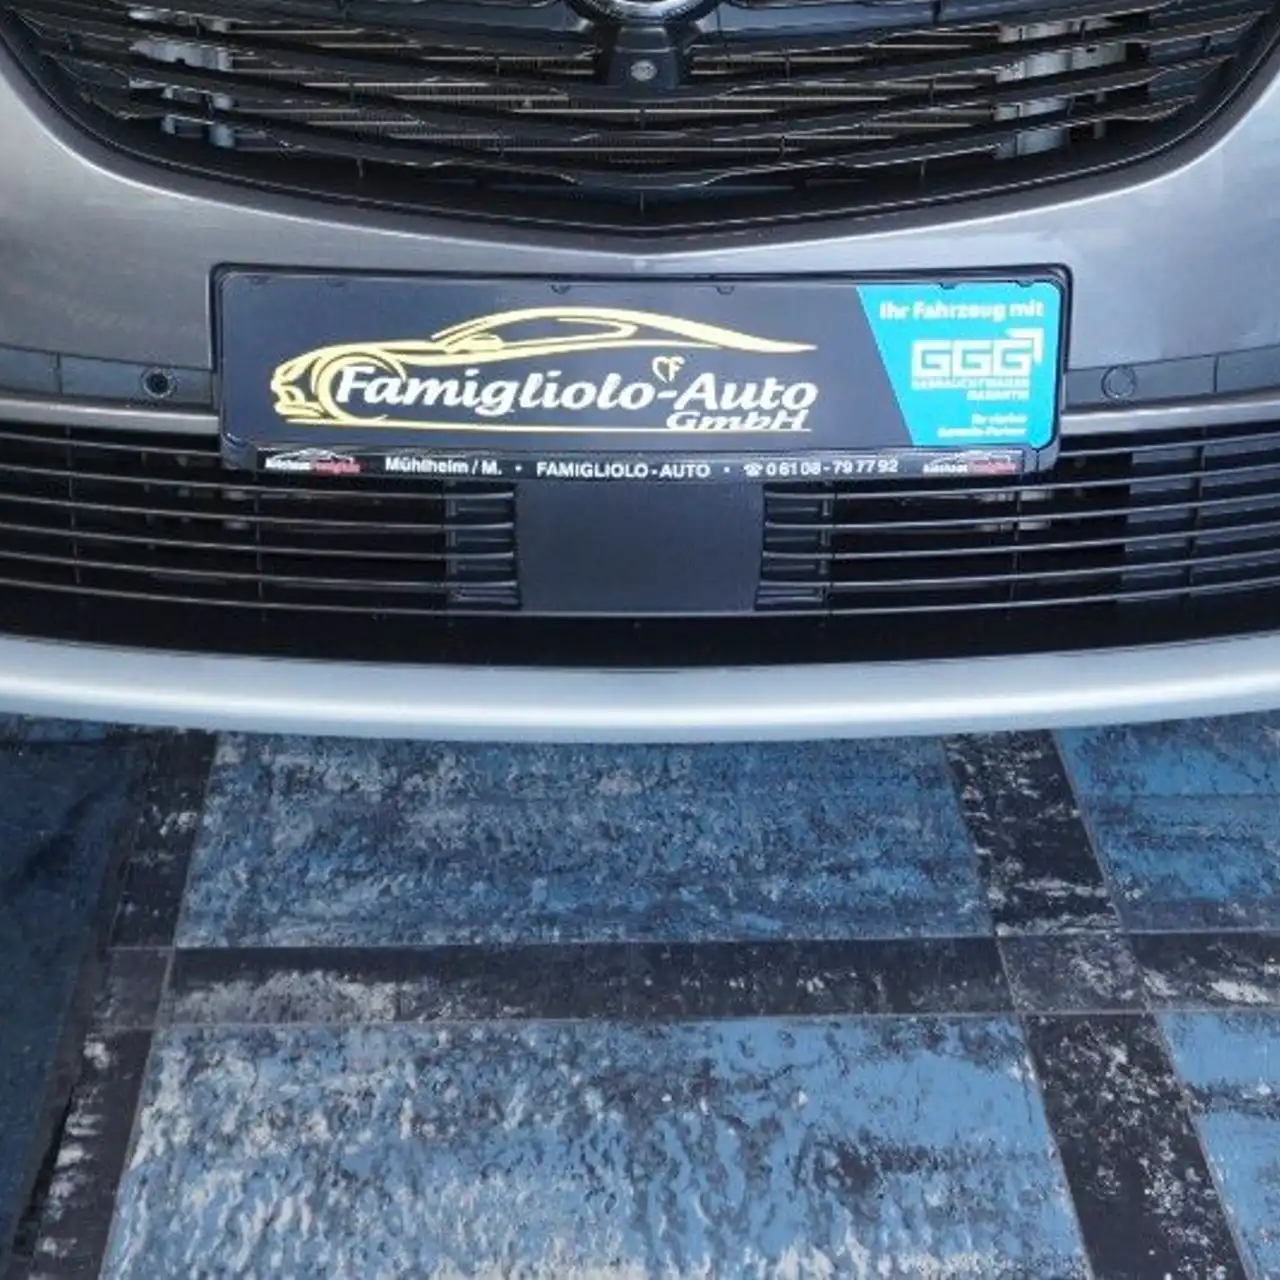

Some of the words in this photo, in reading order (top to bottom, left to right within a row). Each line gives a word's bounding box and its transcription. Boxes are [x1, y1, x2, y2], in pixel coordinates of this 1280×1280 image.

[879, 299, 910, 320] Ihr
[912, 299, 1007, 324] Fahrzeug
[1009, 298, 1045, 318] mit
[910, 338, 1033, 378] GGG
[336, 365, 819, 417] Famigliolo-Auto
[665, 408, 810, 431] GmbH
